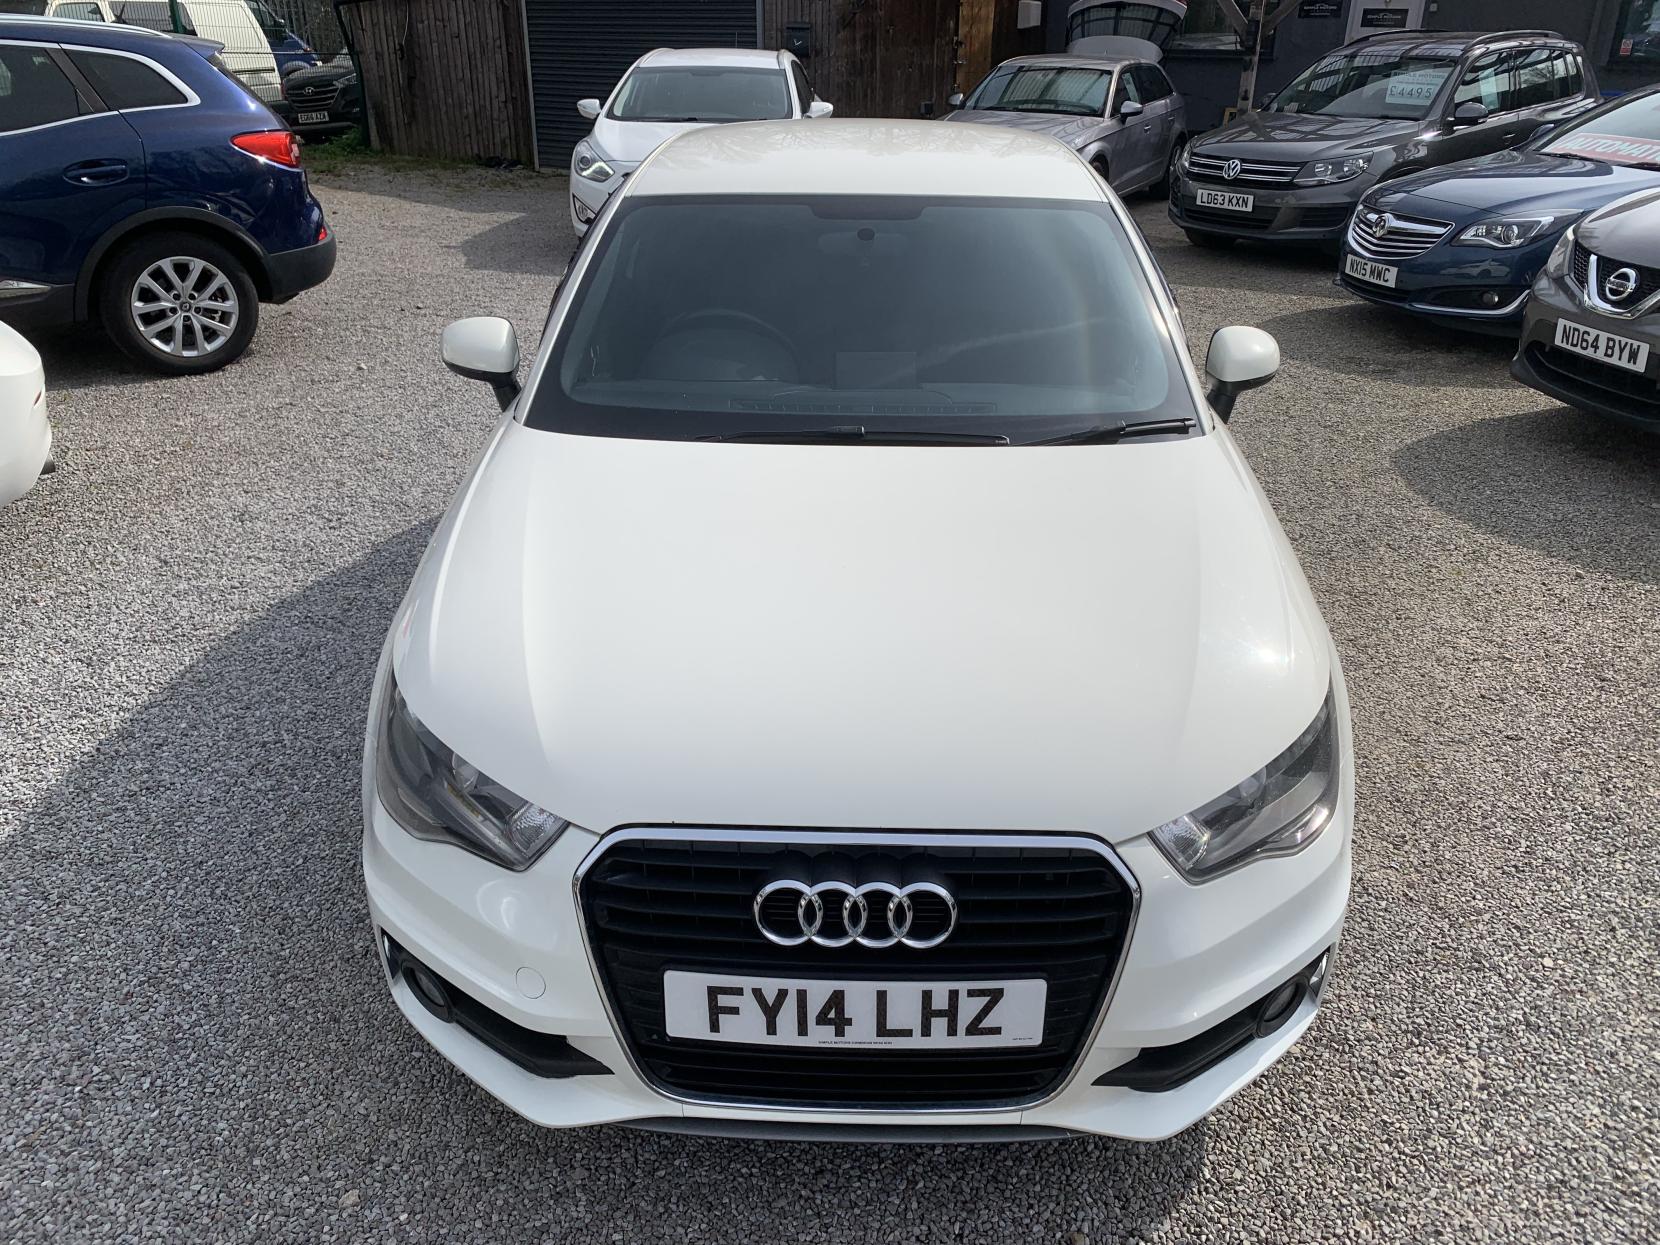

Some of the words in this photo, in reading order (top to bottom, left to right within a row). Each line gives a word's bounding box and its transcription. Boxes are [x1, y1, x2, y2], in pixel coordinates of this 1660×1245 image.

[1389, 85, 1433, 98] £4495
[1200, 192, 1226, 206] LD63
[1227, 195, 1249, 208] KXN
[1349, 258, 1368, 277] NX15
[1369, 264, 1391, 282] MWC
[1561, 324, 1600, 354] ND64
[1603, 336, 1641, 365] BYW
[706, 985, 853, 1038] FY14
[875, 988, 1005, 1038] LHZ
